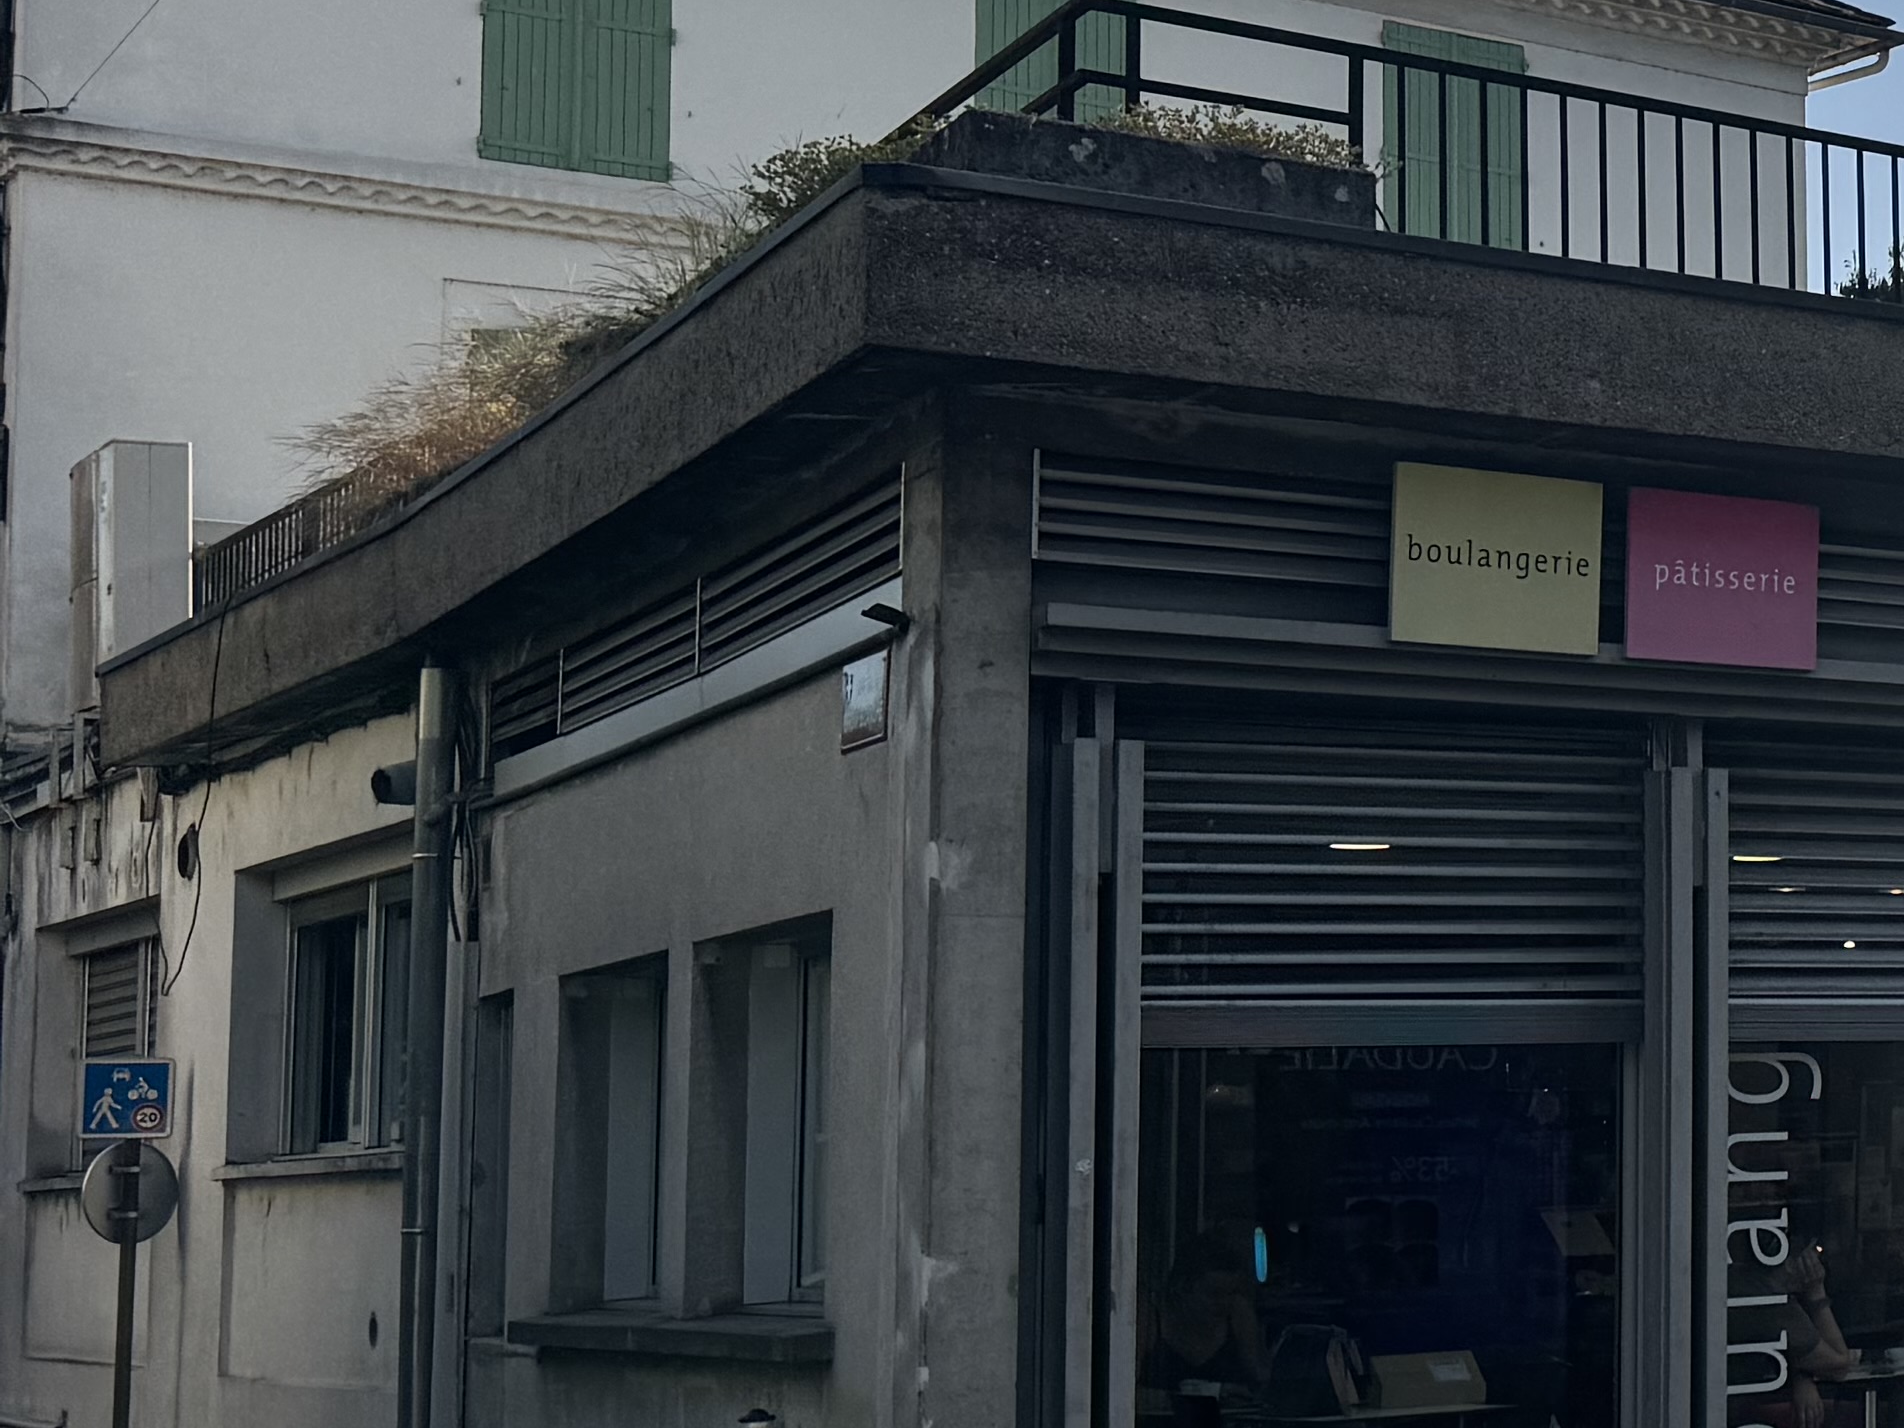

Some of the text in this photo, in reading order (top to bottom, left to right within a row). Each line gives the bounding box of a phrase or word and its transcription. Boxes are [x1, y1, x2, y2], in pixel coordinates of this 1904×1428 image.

[1407, 533, 1591, 580] boulangerie
[1654, 559, 1797, 595] pâtisserie
[138, 1112, 158, 1123] 20
